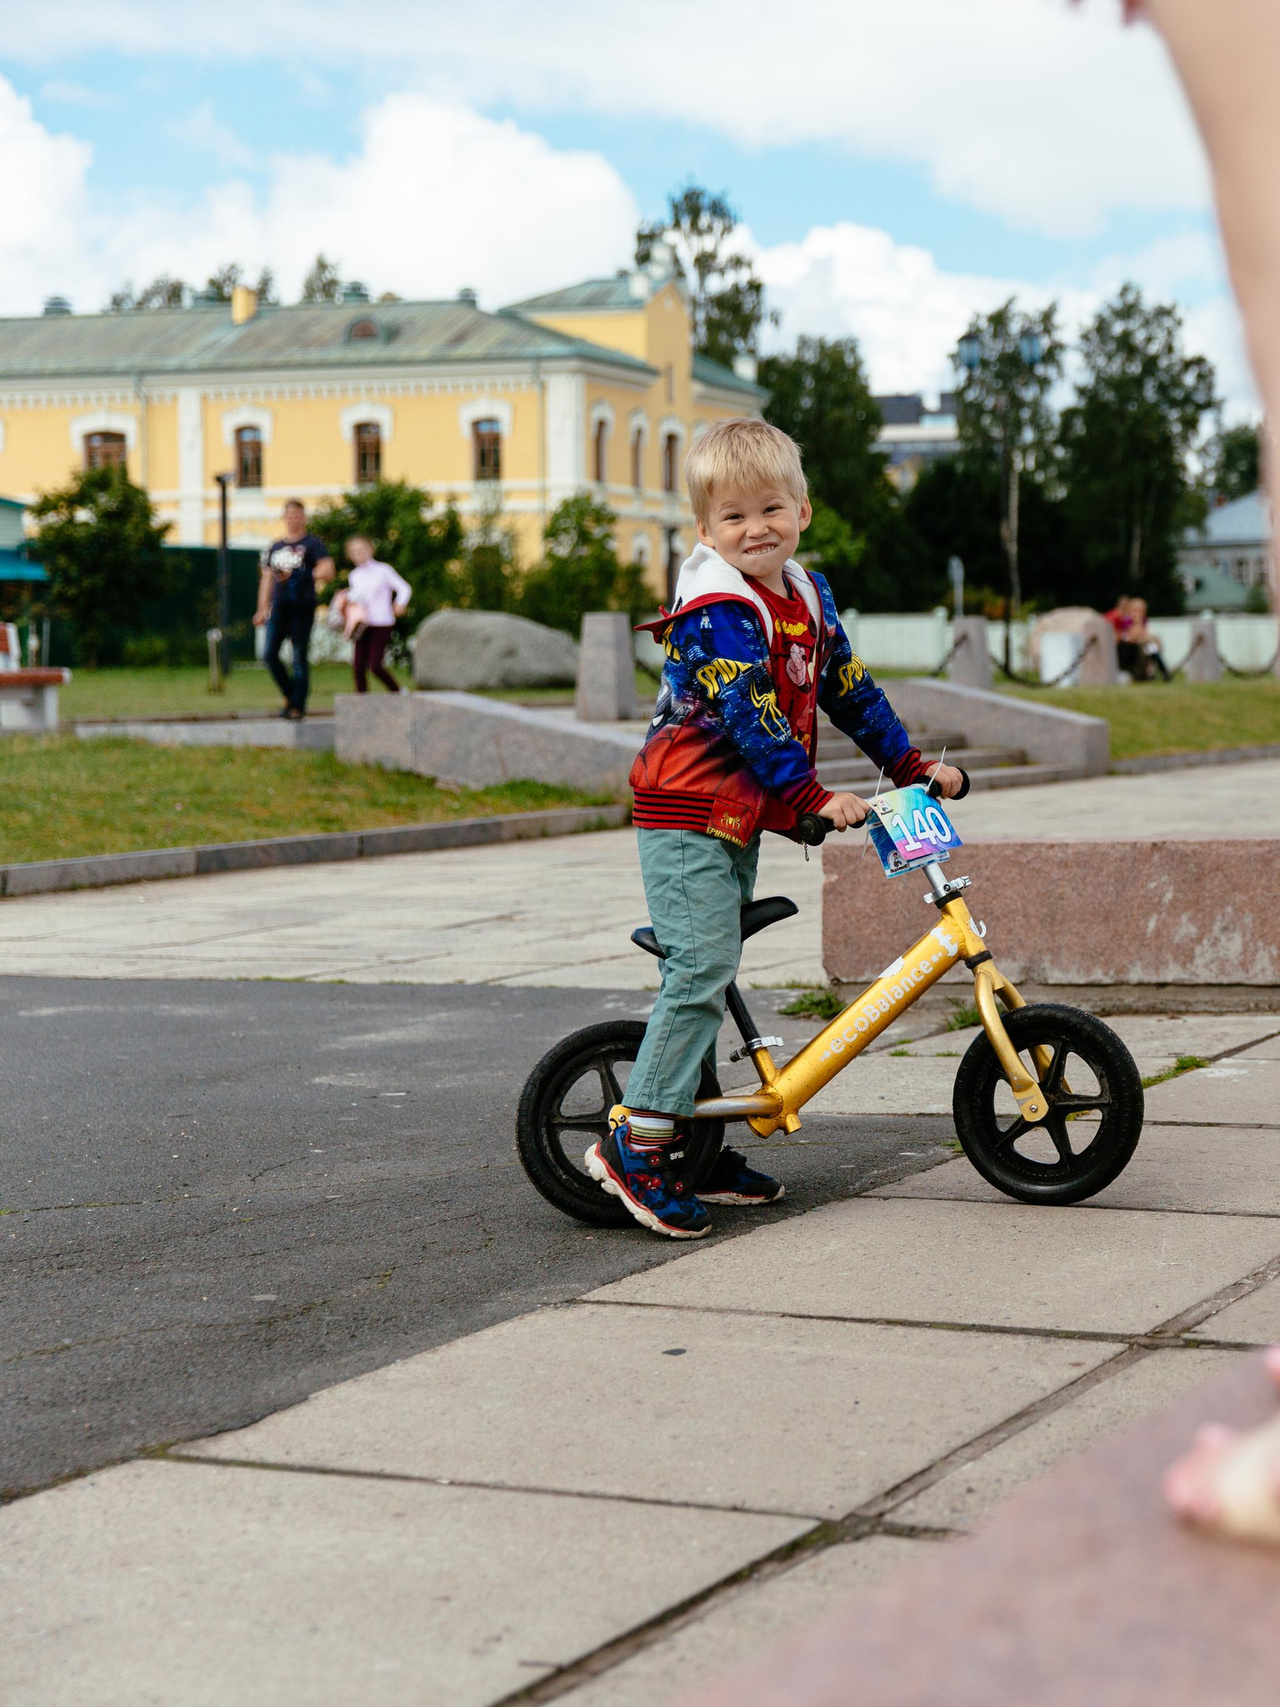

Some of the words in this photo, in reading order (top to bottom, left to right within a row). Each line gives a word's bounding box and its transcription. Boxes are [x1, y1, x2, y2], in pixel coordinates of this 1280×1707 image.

[838, 650, 867, 697] SPID
[891, 806, 952, 852] 140
[830, 958, 934, 1054] ecoBalance
